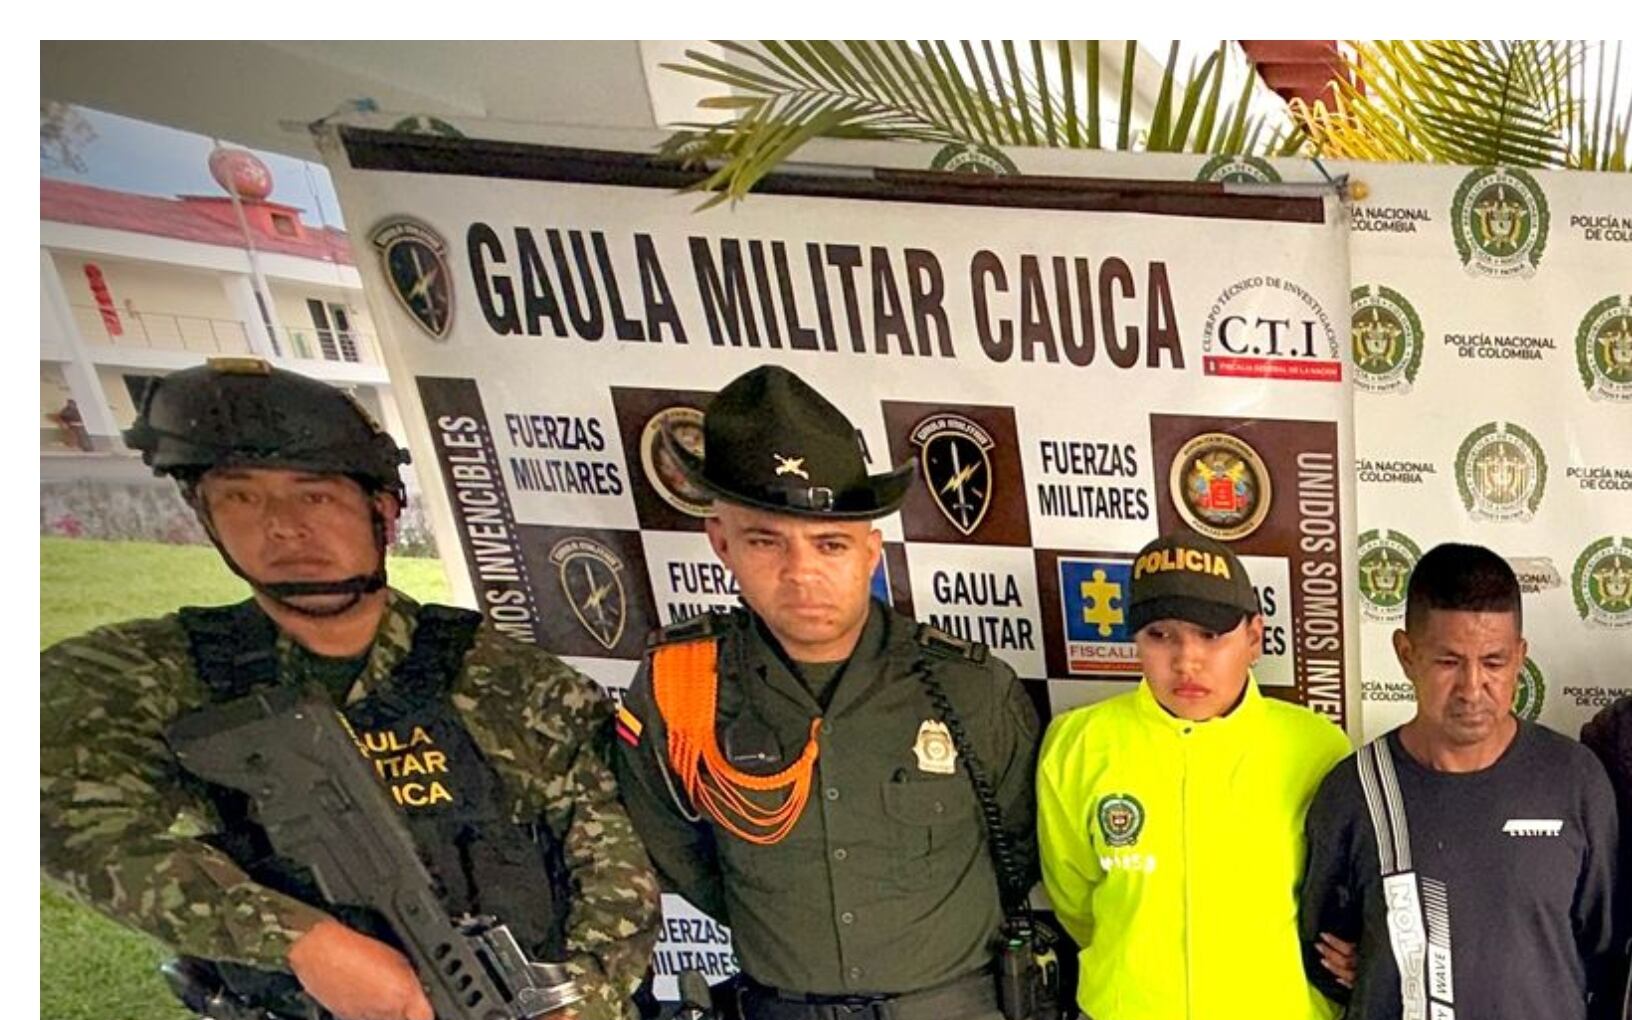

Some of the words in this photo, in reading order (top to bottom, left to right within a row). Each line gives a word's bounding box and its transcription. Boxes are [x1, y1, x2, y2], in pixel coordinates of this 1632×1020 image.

[1365, 208, 1432, 221] NACIONAL
[1570, 215, 1620, 229] POLICÍA
[1585, 228, 1602, 240] DE
[467, 222, 688, 343] GAULA
[689, 236, 956, 359] MILITAR
[970, 249, 1186, 370] CAUCA
[1266, 276, 1281, 289] DE
[1219, 315, 1318, 357] C.T.I
[1444, 334, 1492, 347] POLICÍA
[1494, 336, 1556, 349] NACIONAL
[1458, 346, 1475, 358] DE
[1478, 347, 1542, 360] COLOMBIA
[510, 414, 606, 452] FUERZAS
[511, 457, 624, 495] MILITARES
[1040, 441, 1137, 478] FUERZAS
[1375, 461, 1436, 473] NACIONAL
[1359, 471, 1422, 483] COLOMBIA
[1580, 479, 1596, 490] DE
[438, 414, 519, 582] INVENCIBLES
[1038, 485, 1149, 520] MILITARES
[1298, 452, 1336, 553] UNIDOS
[669, 562, 740, 593] FUERZ
[1136, 547, 1230, 581] POLICIA
[933, 571, 1023, 607] GAULA
[1301, 555, 1339, 651] SOMOS
[1070, 645, 1142, 660] FISCALI
[1435, 952, 1447, 994] WAVE
